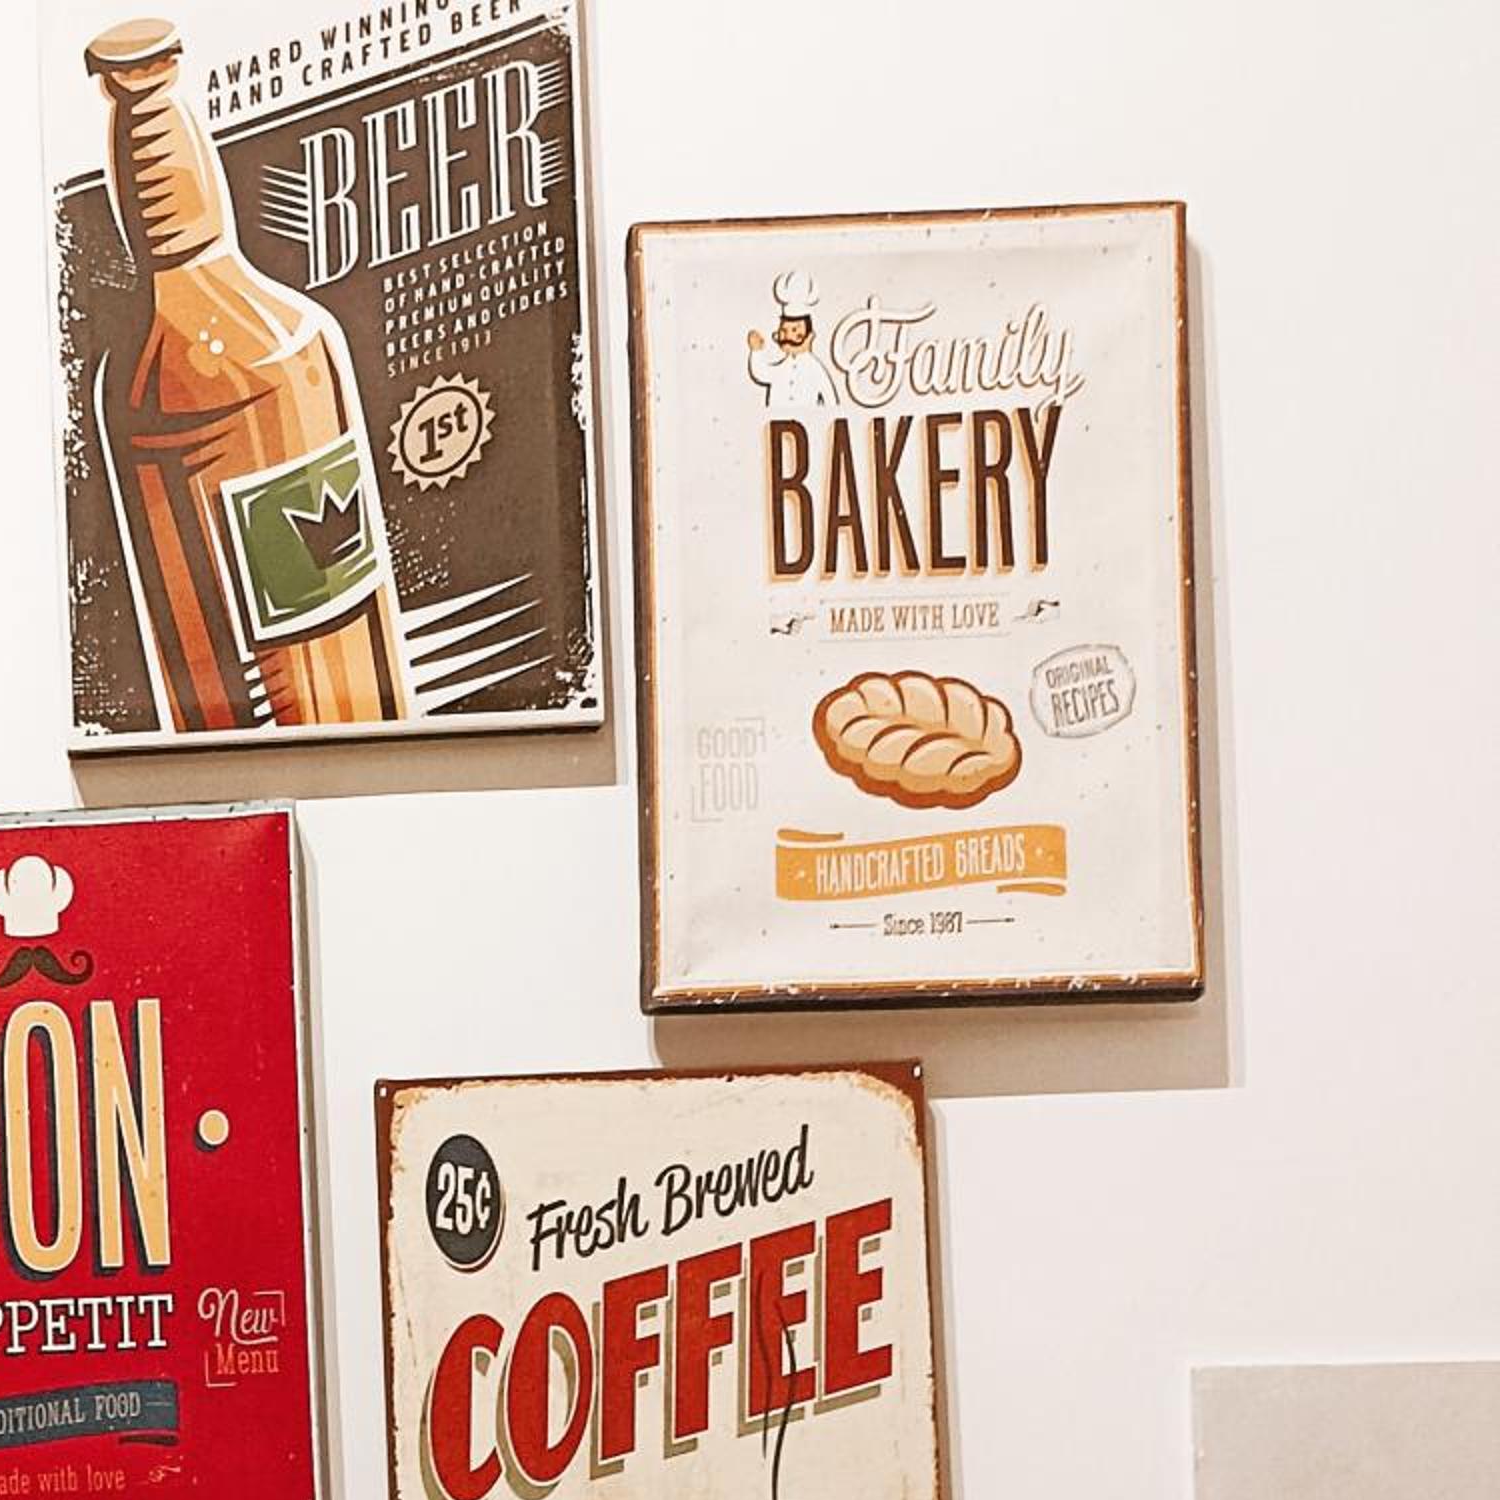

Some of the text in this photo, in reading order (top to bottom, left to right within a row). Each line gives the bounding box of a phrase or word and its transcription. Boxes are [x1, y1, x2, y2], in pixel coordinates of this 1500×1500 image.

[207, 40, 302, 93] AWARD
[208, 0, 521, 120] HAND CRAFTED BEER
[300, 60, 548, 290] BEER
[383, 221, 548, 293] BEST SELECTION
[384, 293, 407, 313] OF
[385, 258, 565, 335] PREMIUM QUALITY
[386, 282, 567, 357] BEERS AND CIDERS
[388, 346, 443, 378] SINCE
[830, 295, 1086, 424] Family
[418, 402, 469, 464] 1st
[763, 405, 1063, 584] BAKERY
[830, 602, 1001, 634] MADE WITH LOVE
[1045, 655, 1114, 689] ORIGINAL
[1051, 678, 1119, 728] RECIPES
[698, 726, 758, 760] GOOD
[699, 762, 758, 814] FOOD
[815, 842, 946, 897] HANDCRAFTED
[882, 912, 926, 936] Since
[526, 1124, 814, 1271] Fresh Brewed
[197, 1287, 280, 1345] New
[215, 1344, 280, 1376] Menu
[94, 1392, 141, 1421] FOOD
[37, 1464, 78, 1493] with
[87, 1463, 127, 1491] love
